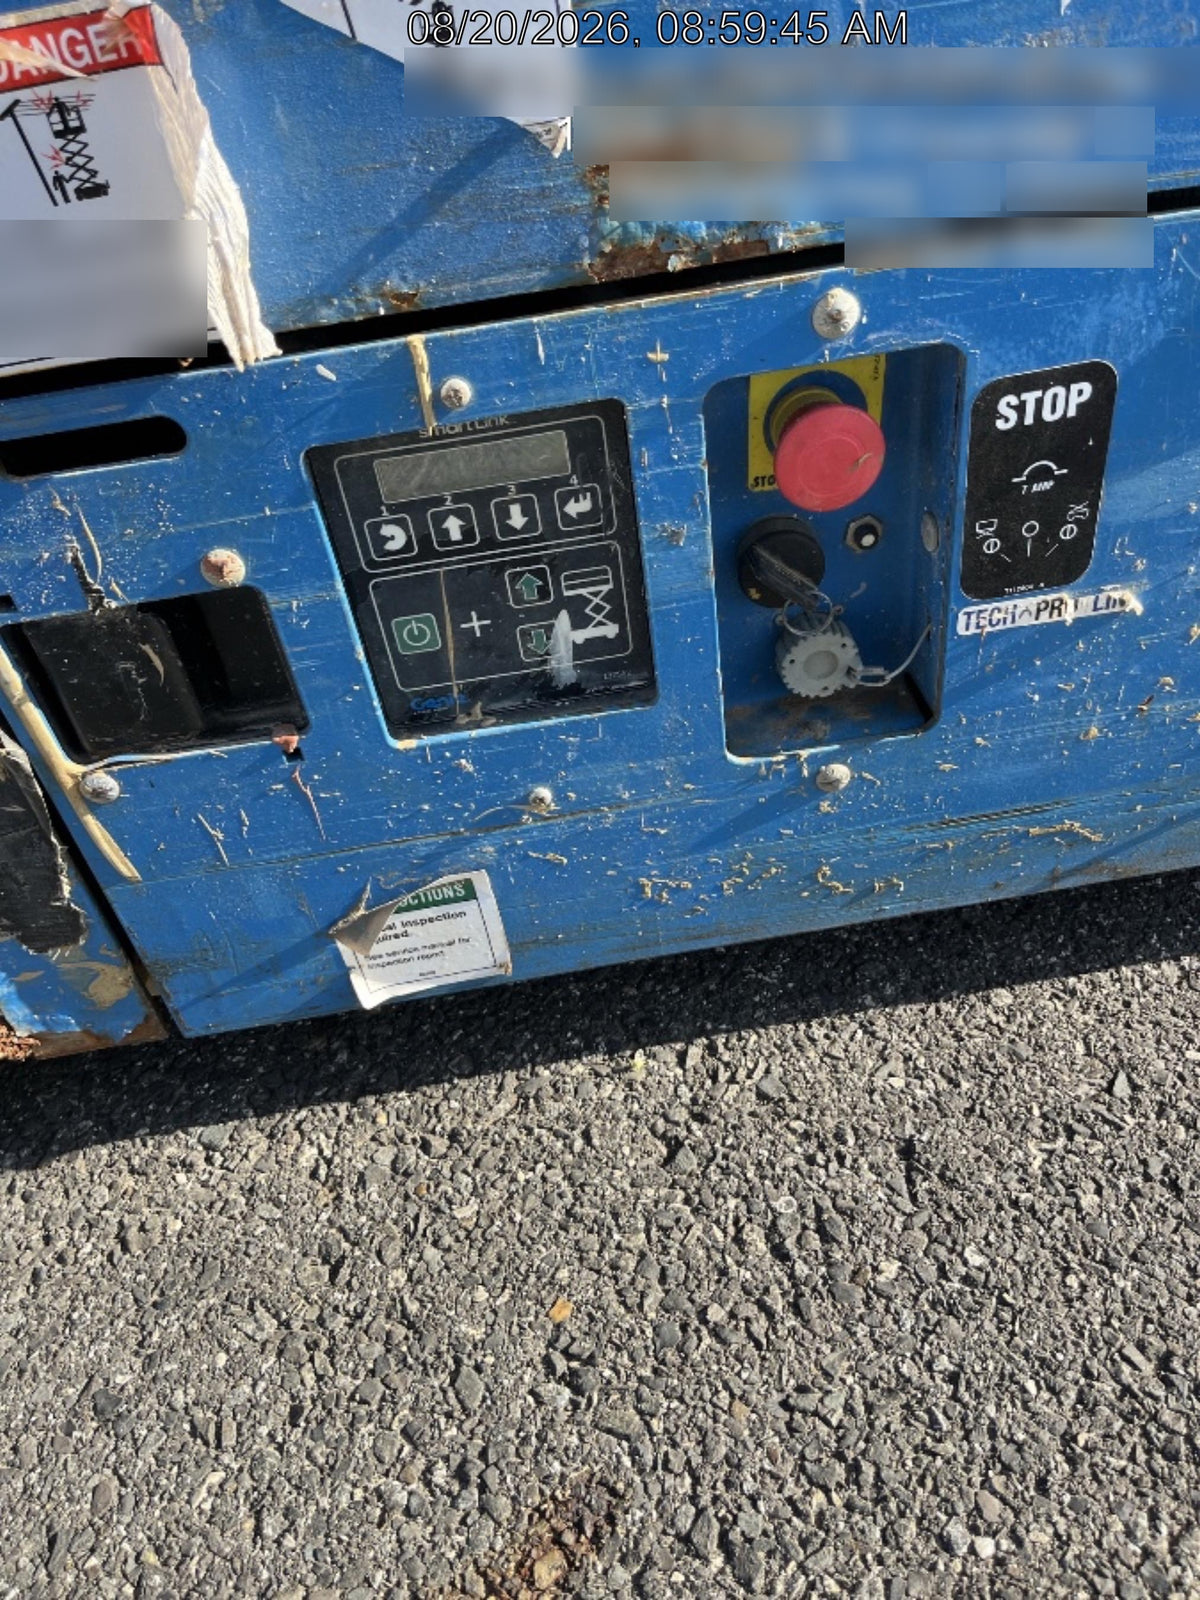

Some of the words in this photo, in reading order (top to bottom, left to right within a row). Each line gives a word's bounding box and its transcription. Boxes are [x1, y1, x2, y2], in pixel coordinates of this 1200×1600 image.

[0, 22, 143, 83] ANGER
[995, 381, 1093, 431] STOP
[569, 475, 579, 485] 4
[753, 474, 777, 488] STO
[507, 485, 517, 496] 3
[443, 495, 453, 506] 2
[379, 505, 390, 517] 1
[962, 604, 1018, 632] TECH
